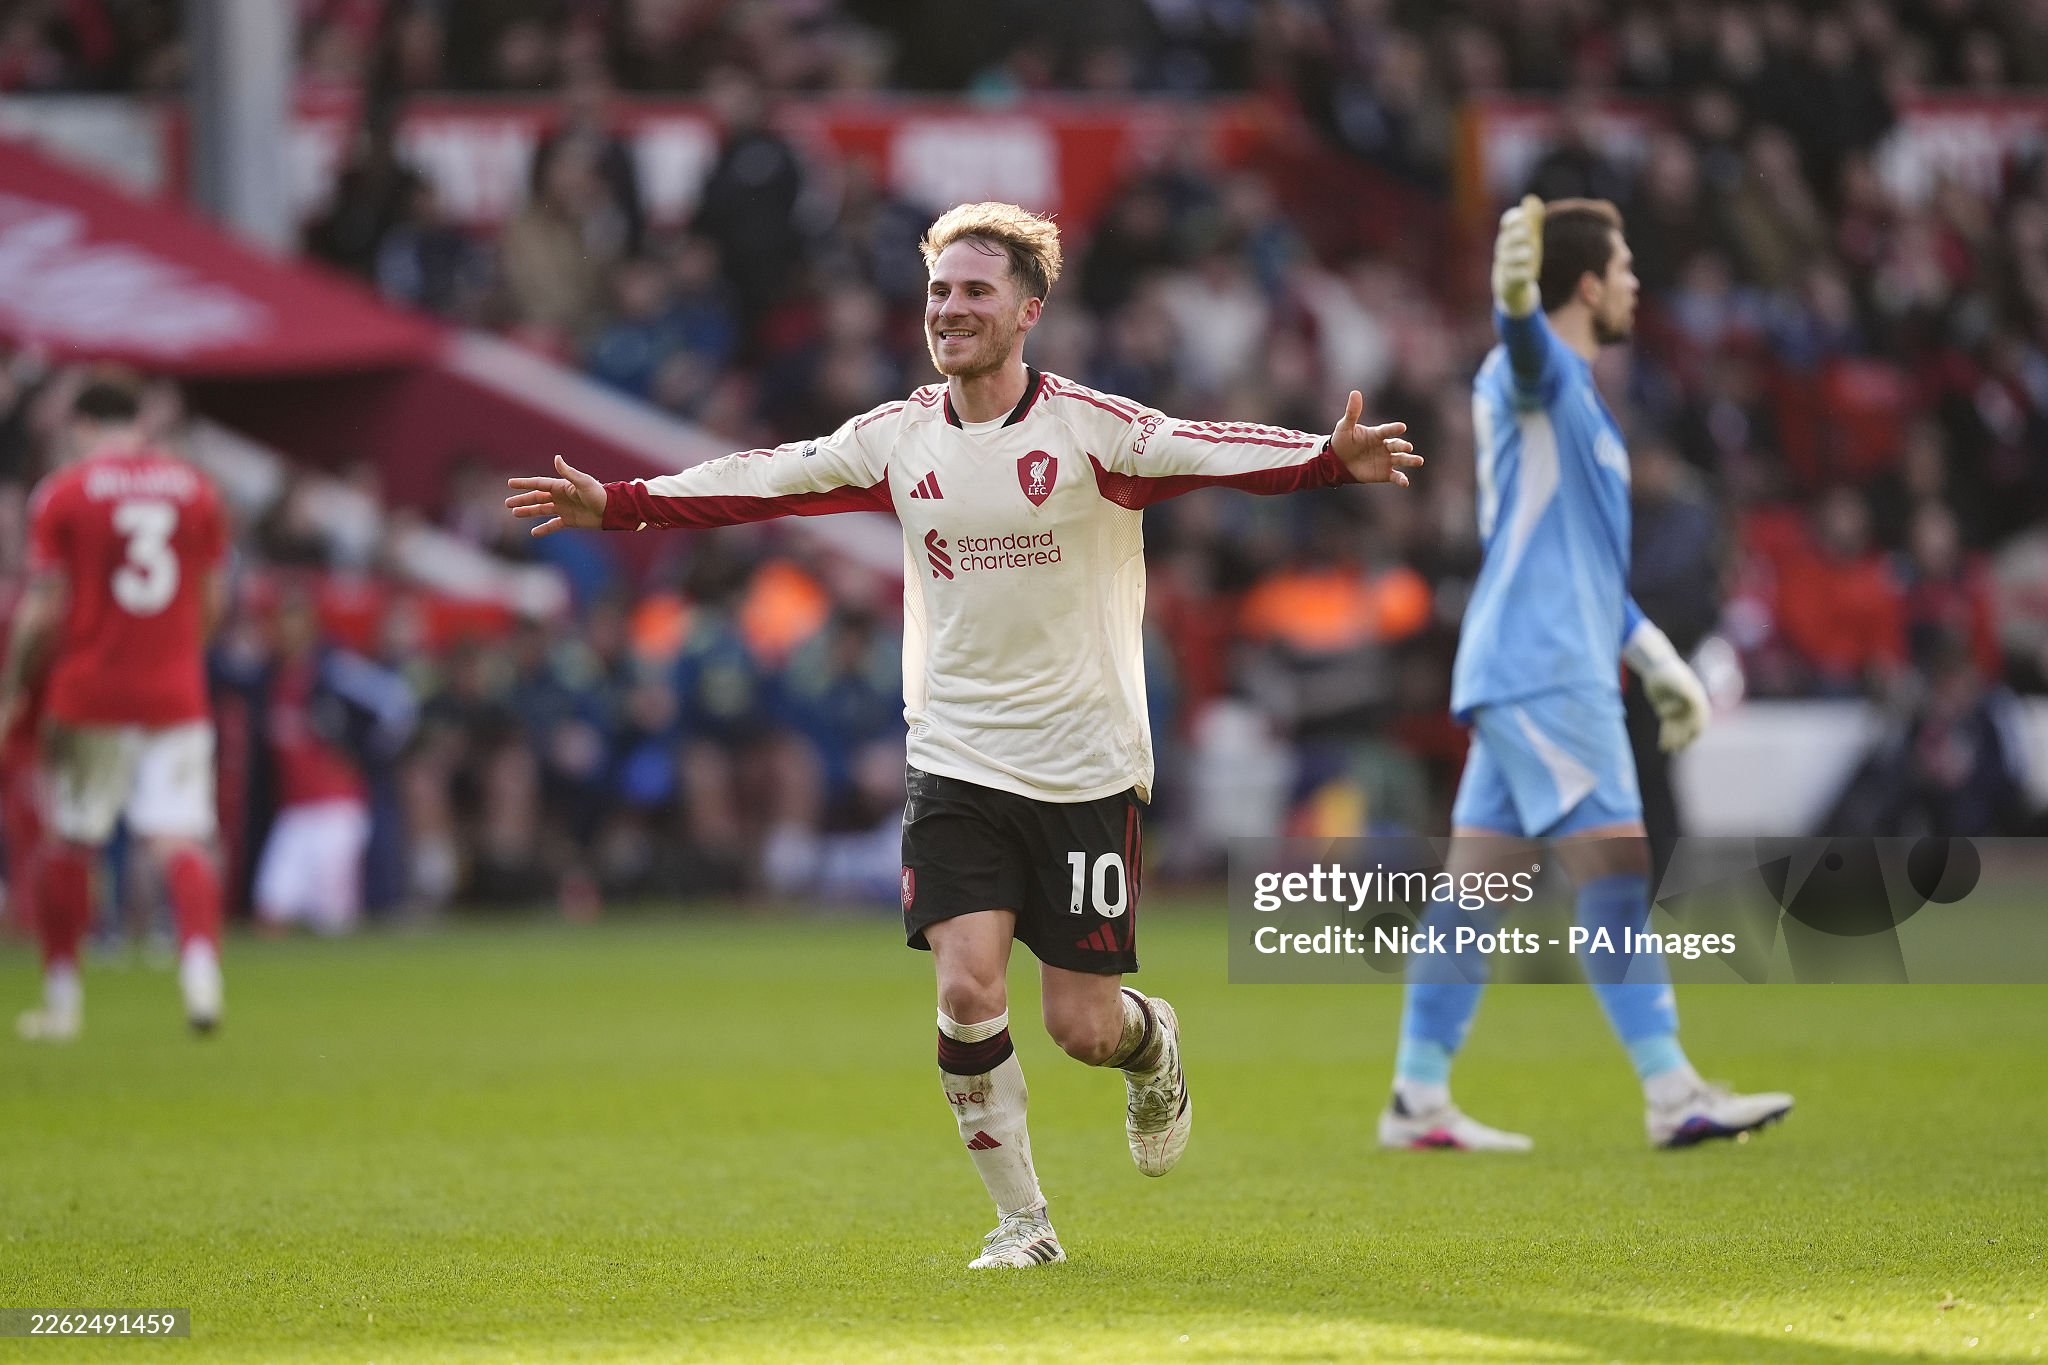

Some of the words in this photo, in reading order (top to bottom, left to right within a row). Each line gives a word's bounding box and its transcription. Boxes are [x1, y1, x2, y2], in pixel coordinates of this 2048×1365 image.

[957, 529, 1054, 553] standard
[111, 500, 181, 617] 3
[960, 545, 1062, 572] chartered
[1067, 851, 1128, 919] 10
[945, 1090, 985, 1106] LFC
